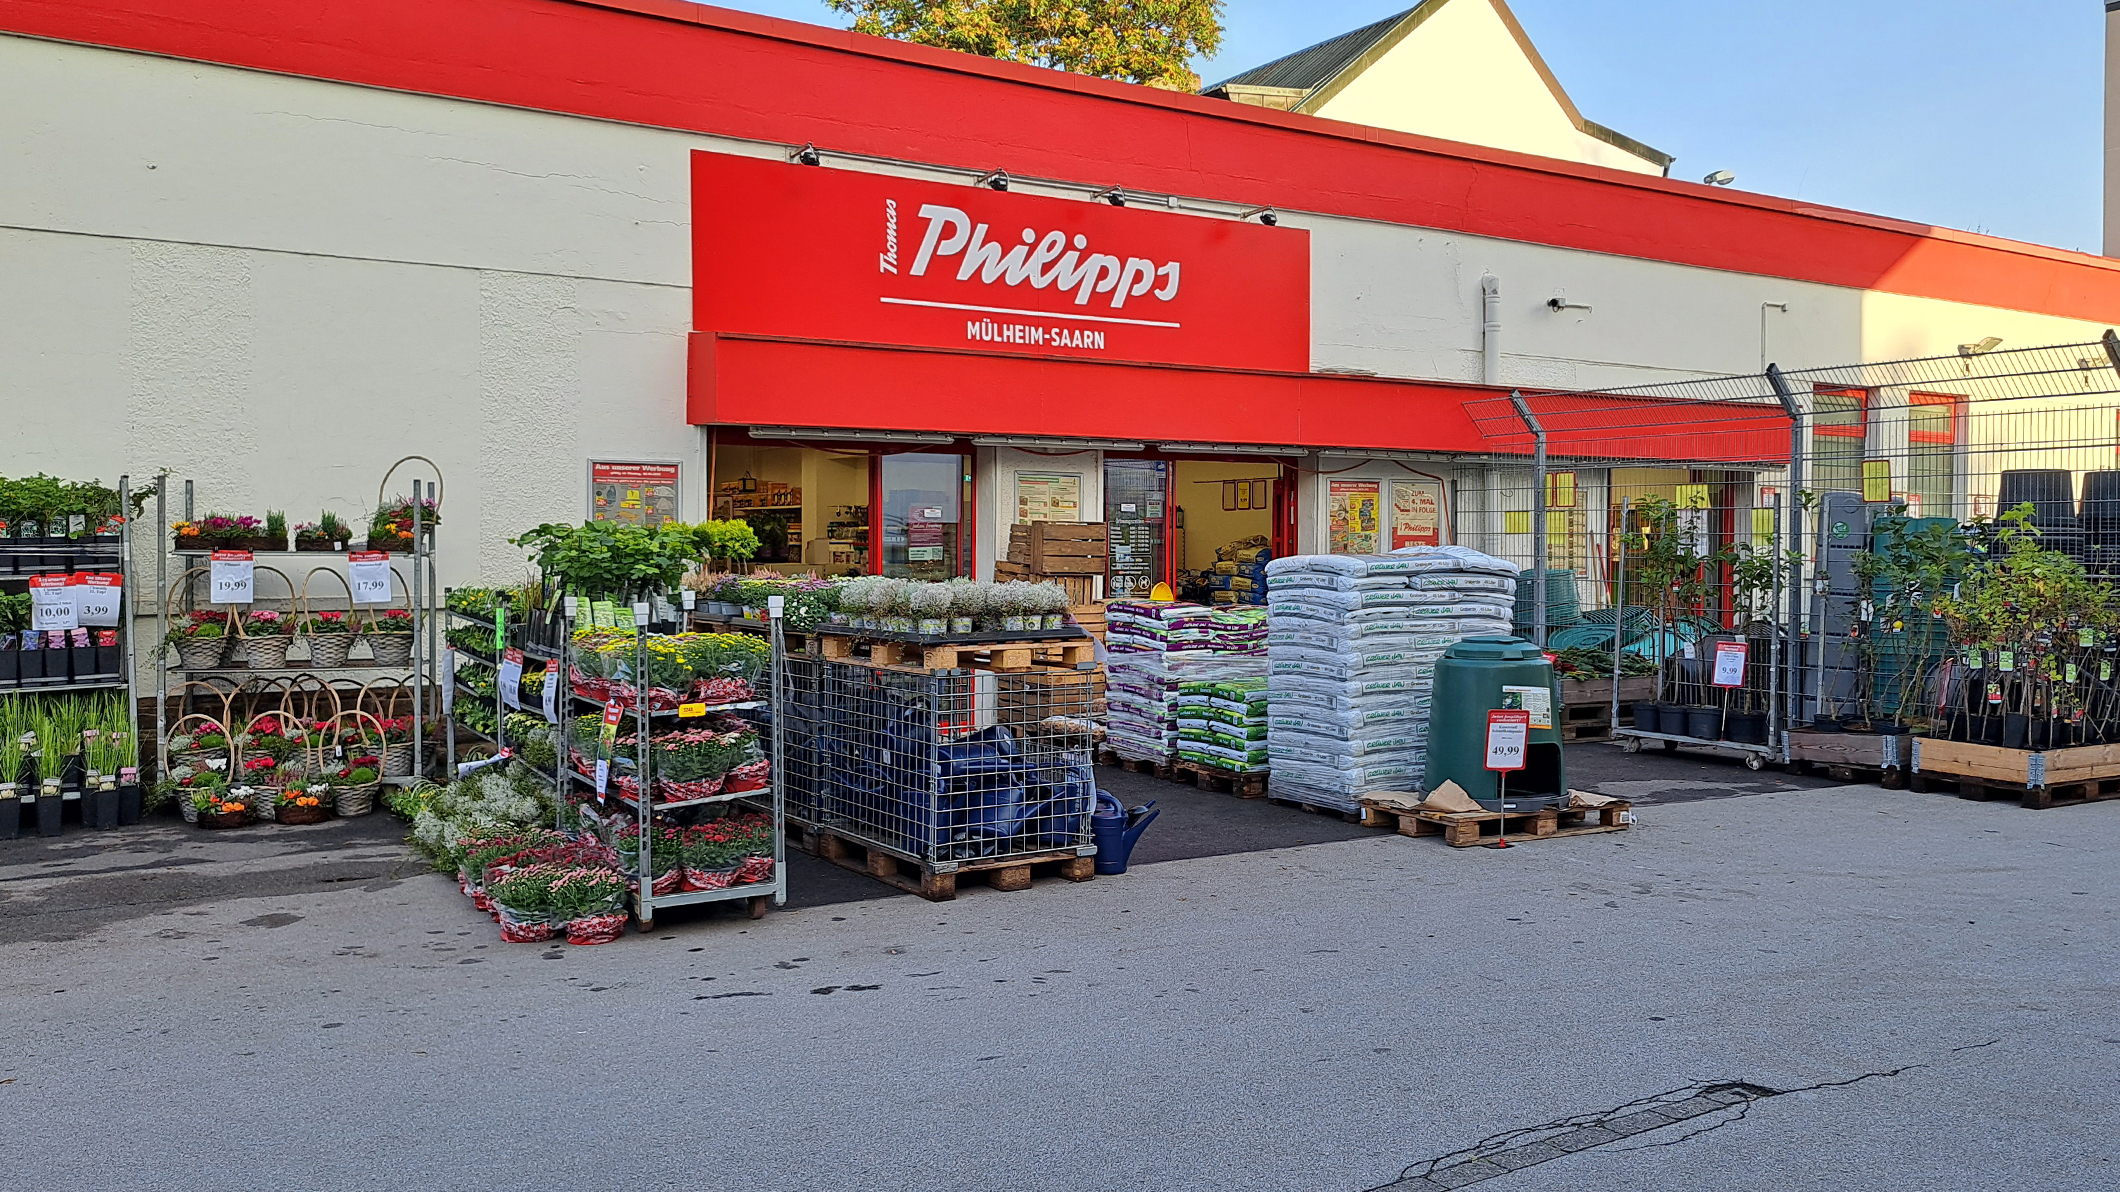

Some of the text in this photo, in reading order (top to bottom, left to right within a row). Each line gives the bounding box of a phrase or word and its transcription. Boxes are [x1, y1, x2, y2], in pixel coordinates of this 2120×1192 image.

[880, 199, 898, 275] Thomas
[909, 203, 1180, 309] Philipps
[966, 318, 1105, 350] MÜLHEIM-SAARN
[1403, 523, 1431, 532] Philipps
[219, 581, 247, 591] 19,99
[357, 581, 384, 591] 17,99
[40, 607, 70, 618] 10,00
[83, 605, 108, 616] 3,99
[1722, 667, 1737, 675] 9,99
[1492, 746, 1519, 757] 49,99
